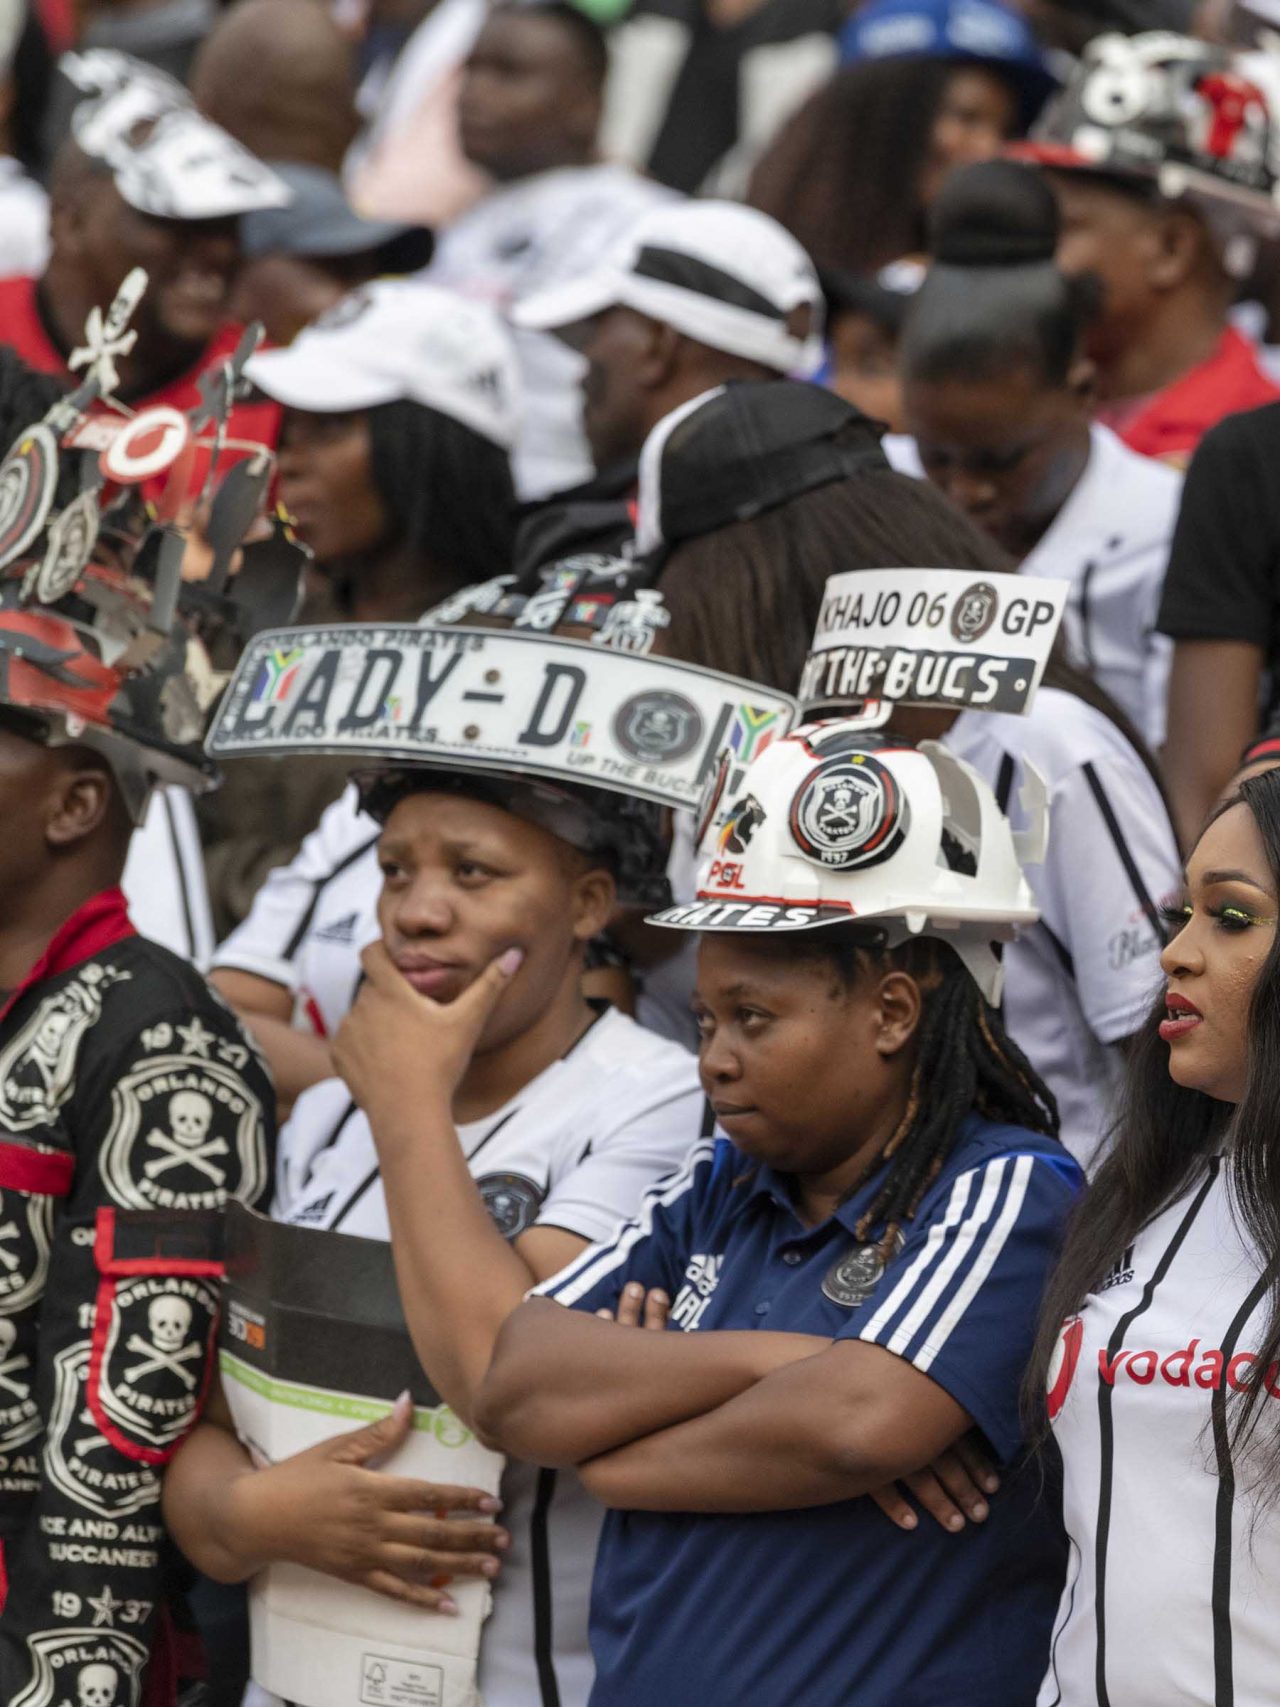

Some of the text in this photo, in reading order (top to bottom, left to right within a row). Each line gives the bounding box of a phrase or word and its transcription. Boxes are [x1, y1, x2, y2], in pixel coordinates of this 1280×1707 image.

[907, 591, 947, 629] 06
[1001, 598, 1055, 638] GP
[883, 650, 1009, 704] BUCS
[566, 751, 597, 768] UP
[601, 757, 635, 780] THE
[135, 1073, 246, 1115] ORLANDO
[68, 1517, 119, 1541] AND
[52, 1589, 82, 1618] 19
